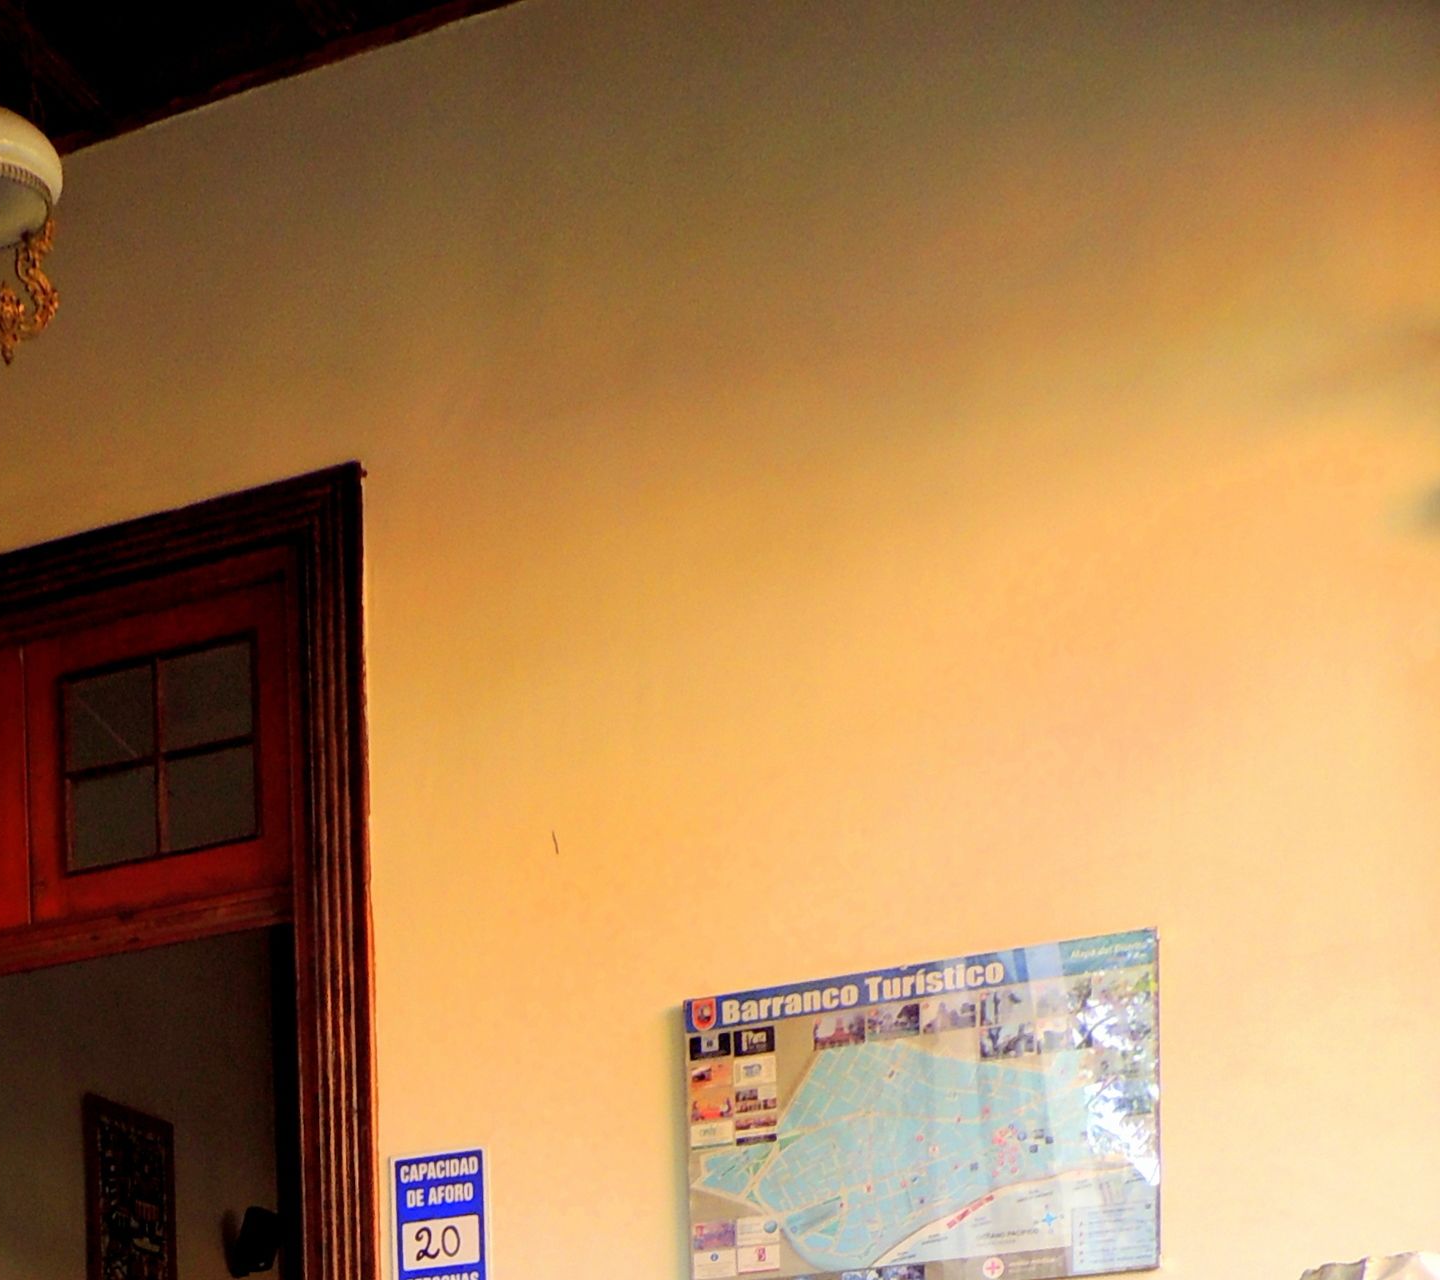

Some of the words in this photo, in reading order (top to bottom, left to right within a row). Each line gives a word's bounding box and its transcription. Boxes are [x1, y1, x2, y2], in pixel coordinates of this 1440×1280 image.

[721, 983, 859, 1024] Barranco
[864, 960, 1005, 1002] Turístico
[400, 1155, 479, 1184] CAPACIDAD
[406, 1188, 425, 1208] DE
[428, 1182, 474, 1206] AFORO
[414, 1225, 461, 1262] 20
